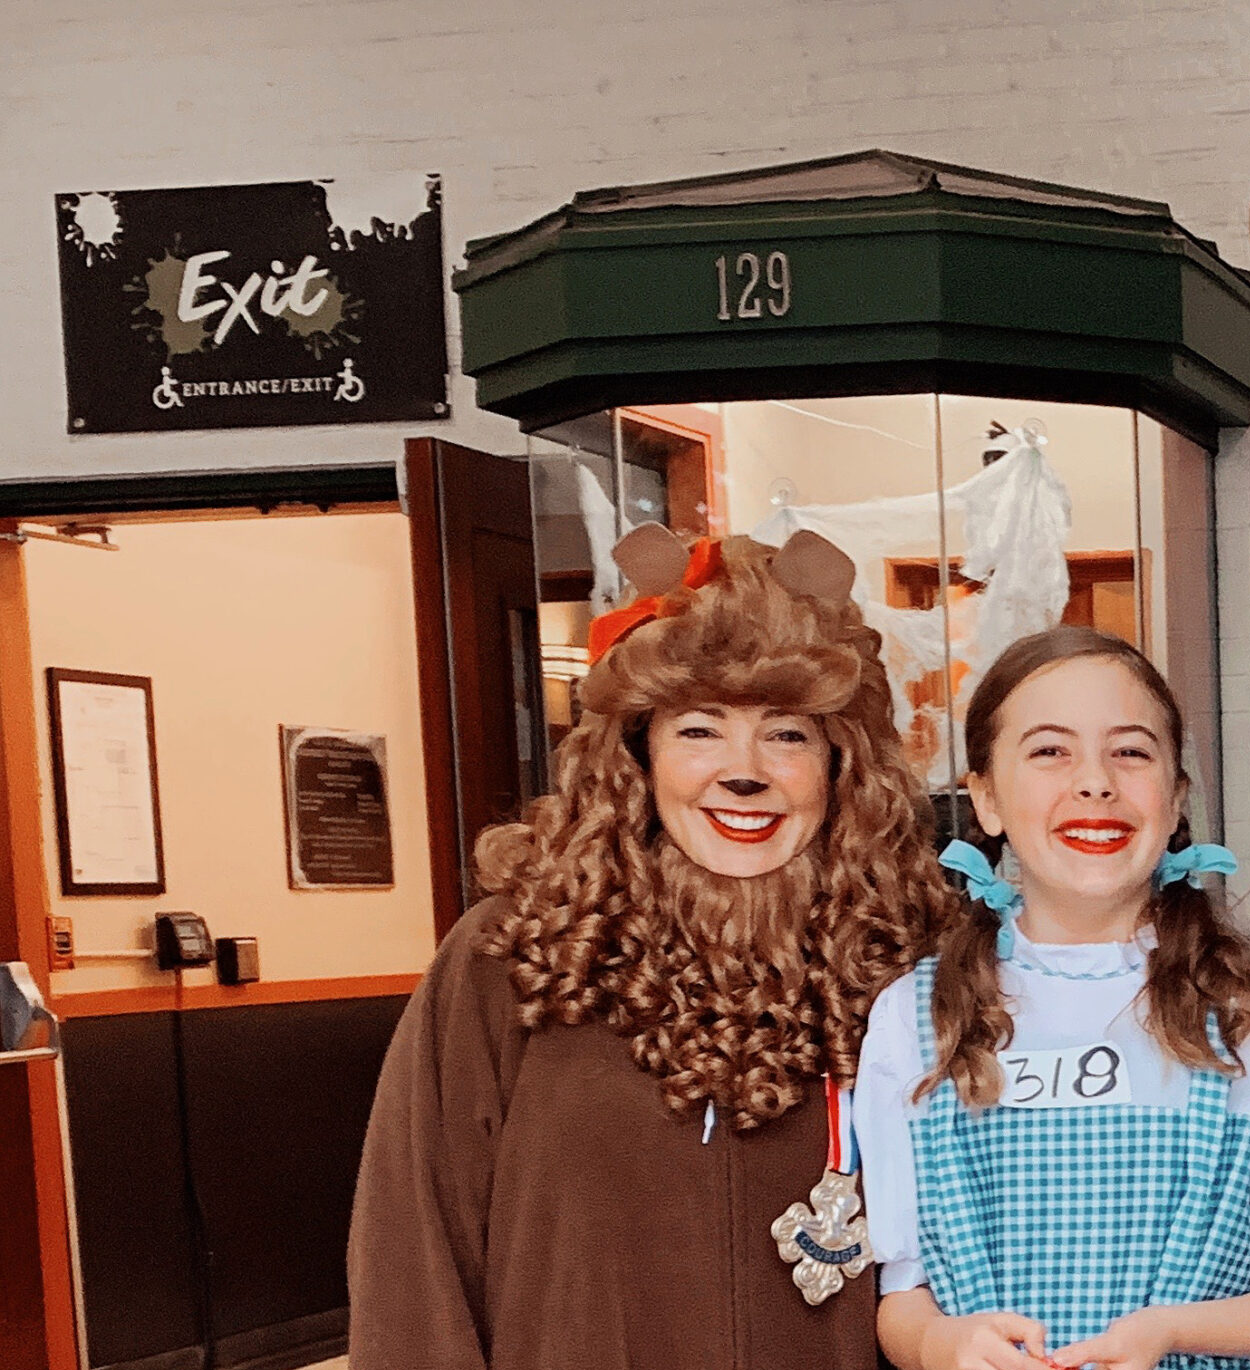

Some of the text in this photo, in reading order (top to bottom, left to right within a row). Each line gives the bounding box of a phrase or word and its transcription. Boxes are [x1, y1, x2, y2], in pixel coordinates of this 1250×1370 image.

[178, 250, 330, 345] Exit
[715, 251, 790, 320] 129
[183, 376, 334, 399] ENTRANCE/EXIT
[1005, 1045, 1121, 1103] 318
